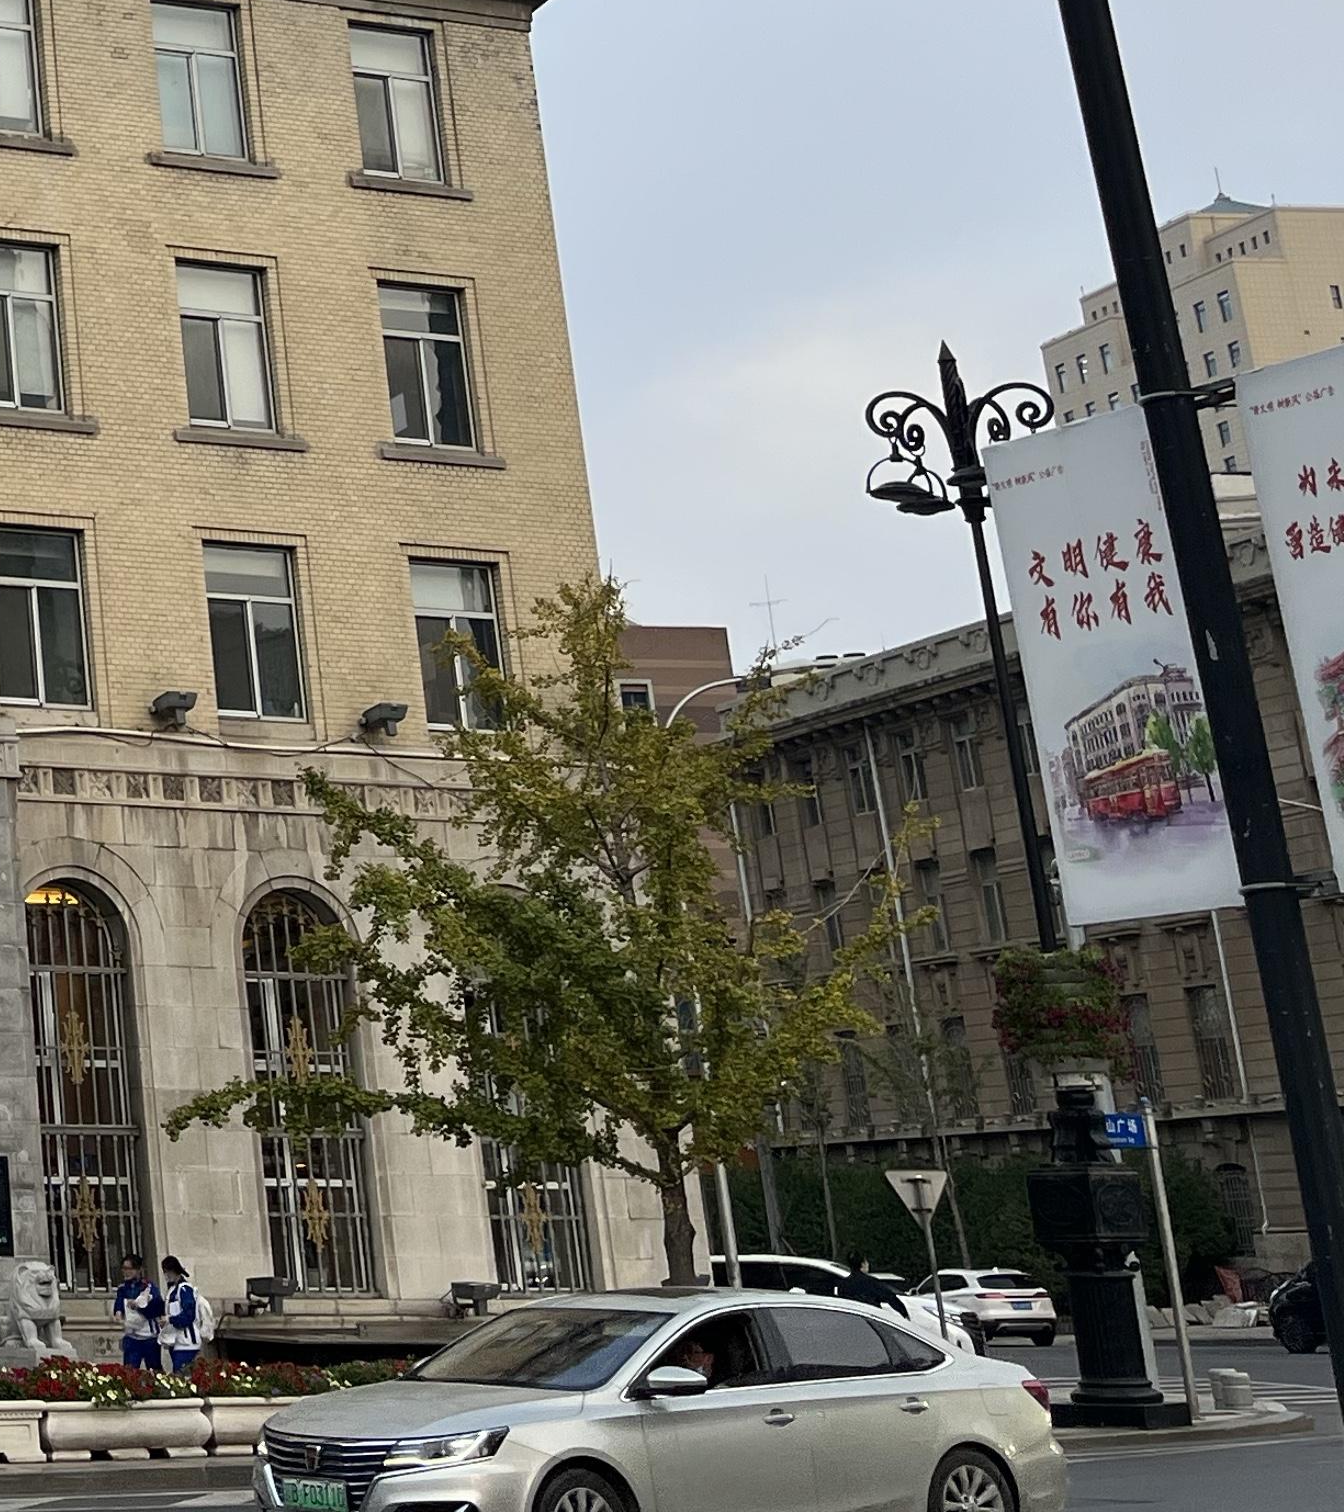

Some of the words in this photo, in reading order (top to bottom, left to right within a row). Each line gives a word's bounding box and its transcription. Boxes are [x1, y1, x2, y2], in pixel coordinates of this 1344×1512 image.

[1028, 518, 1163, 587] 文明健康
[1040, 572, 1174, 641] 有你有我
[1106, 1118, 1138, 1134] 山广场
